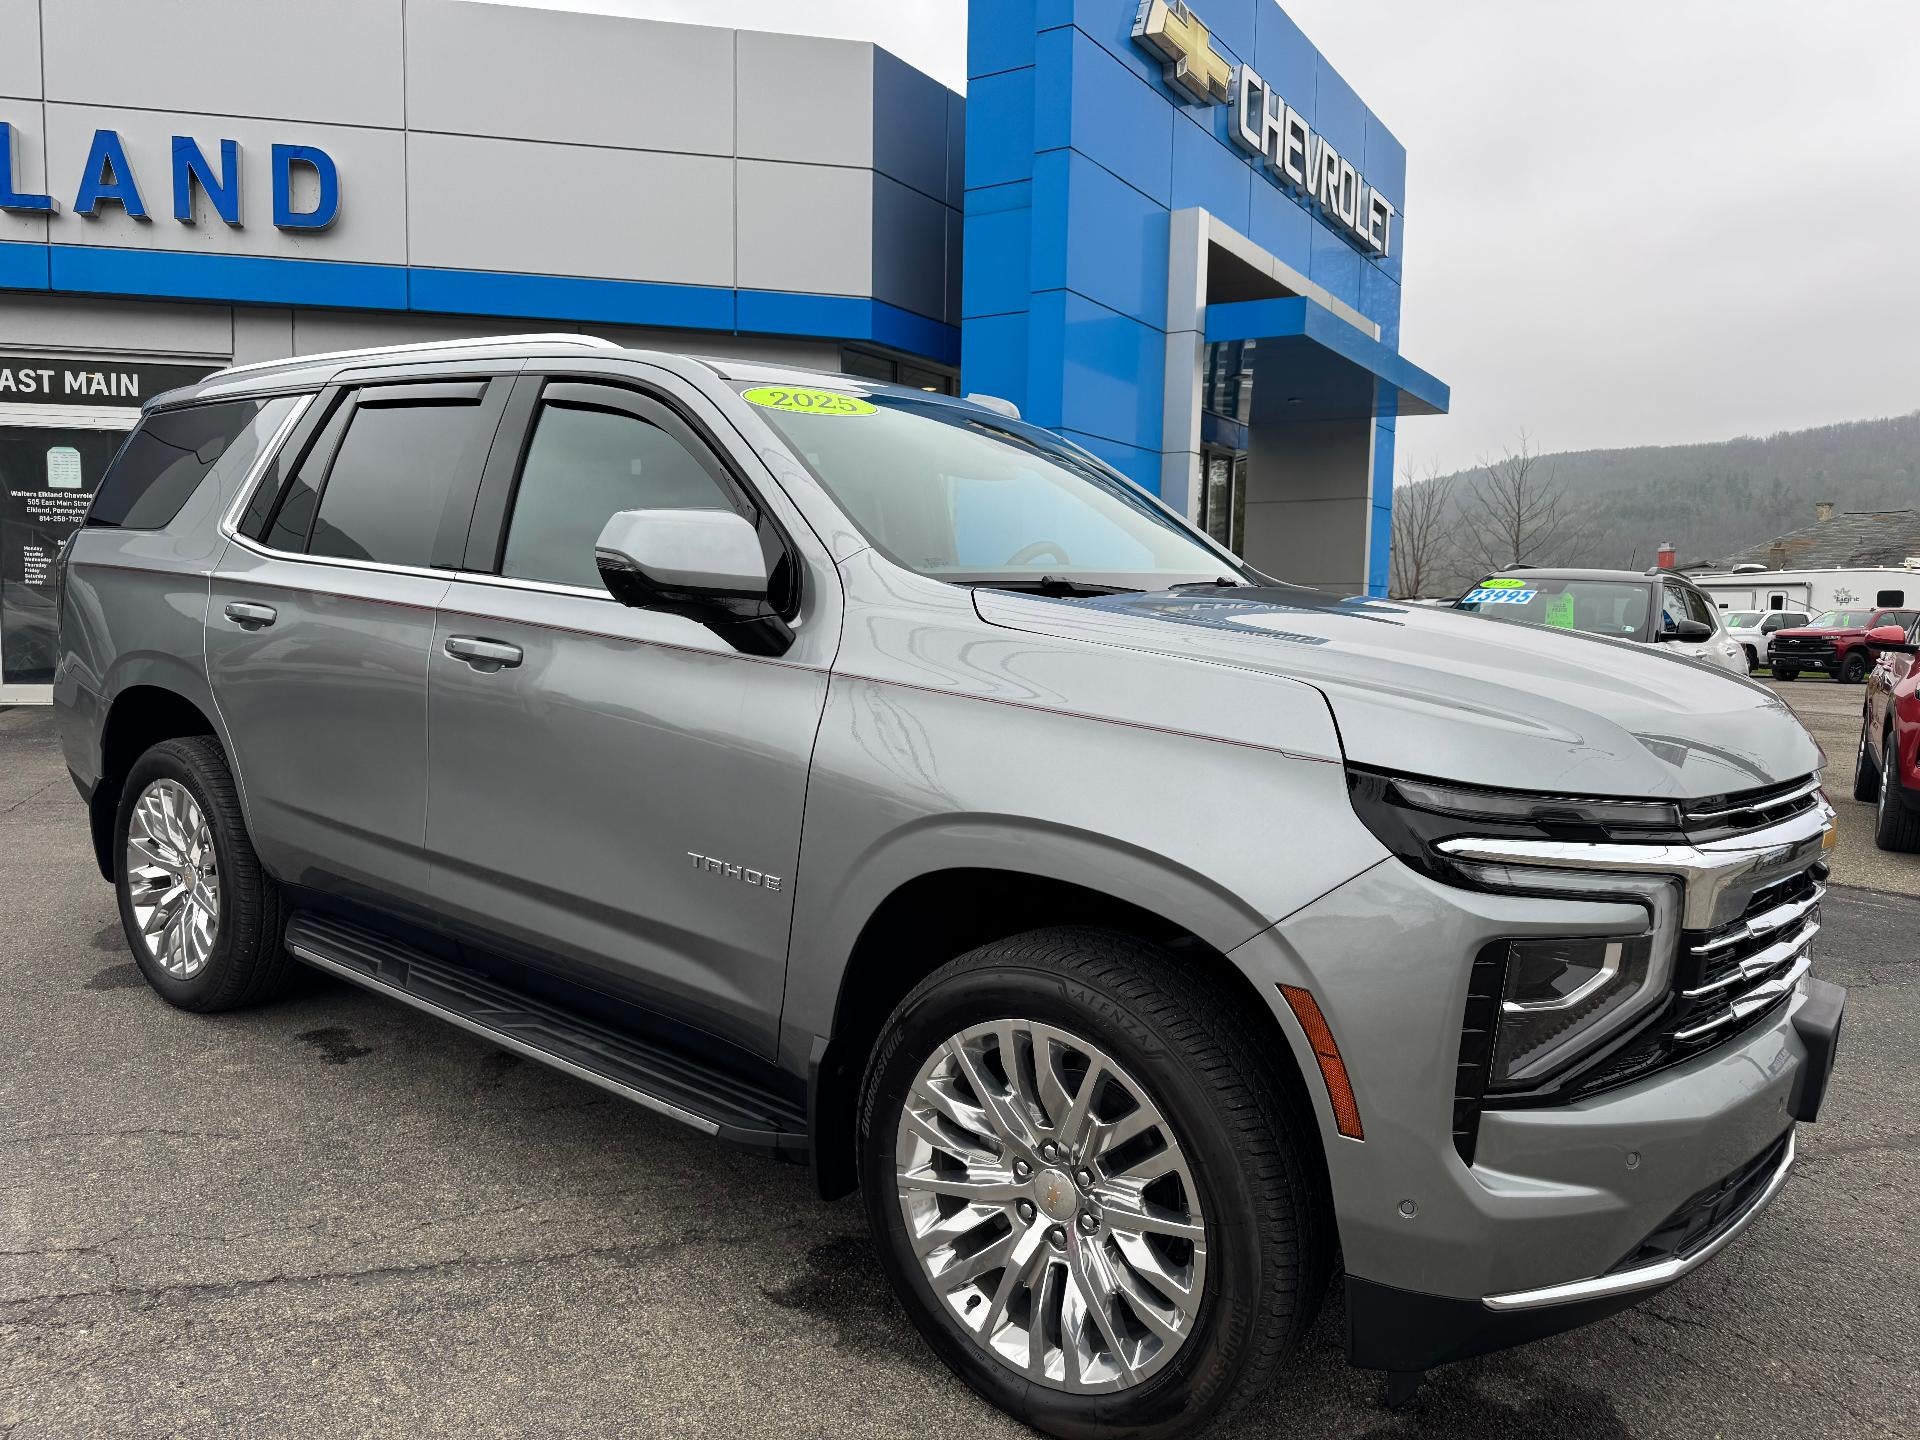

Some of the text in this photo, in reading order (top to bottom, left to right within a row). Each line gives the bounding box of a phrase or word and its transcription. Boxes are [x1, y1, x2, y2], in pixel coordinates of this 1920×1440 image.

[0, 121, 341, 230] LAND
[1239, 63, 1394, 258] CHEVROLET
[0, 368, 139, 397] AST MAIN
[769, 391, 858, 412] 2025
[1467, 589, 1535, 603] 23995
[687, 851, 781, 892] TAHOE
[1073, 990, 1149, 1046] ALENZA
[861, 1024, 905, 1139] BRIDGESTONE
